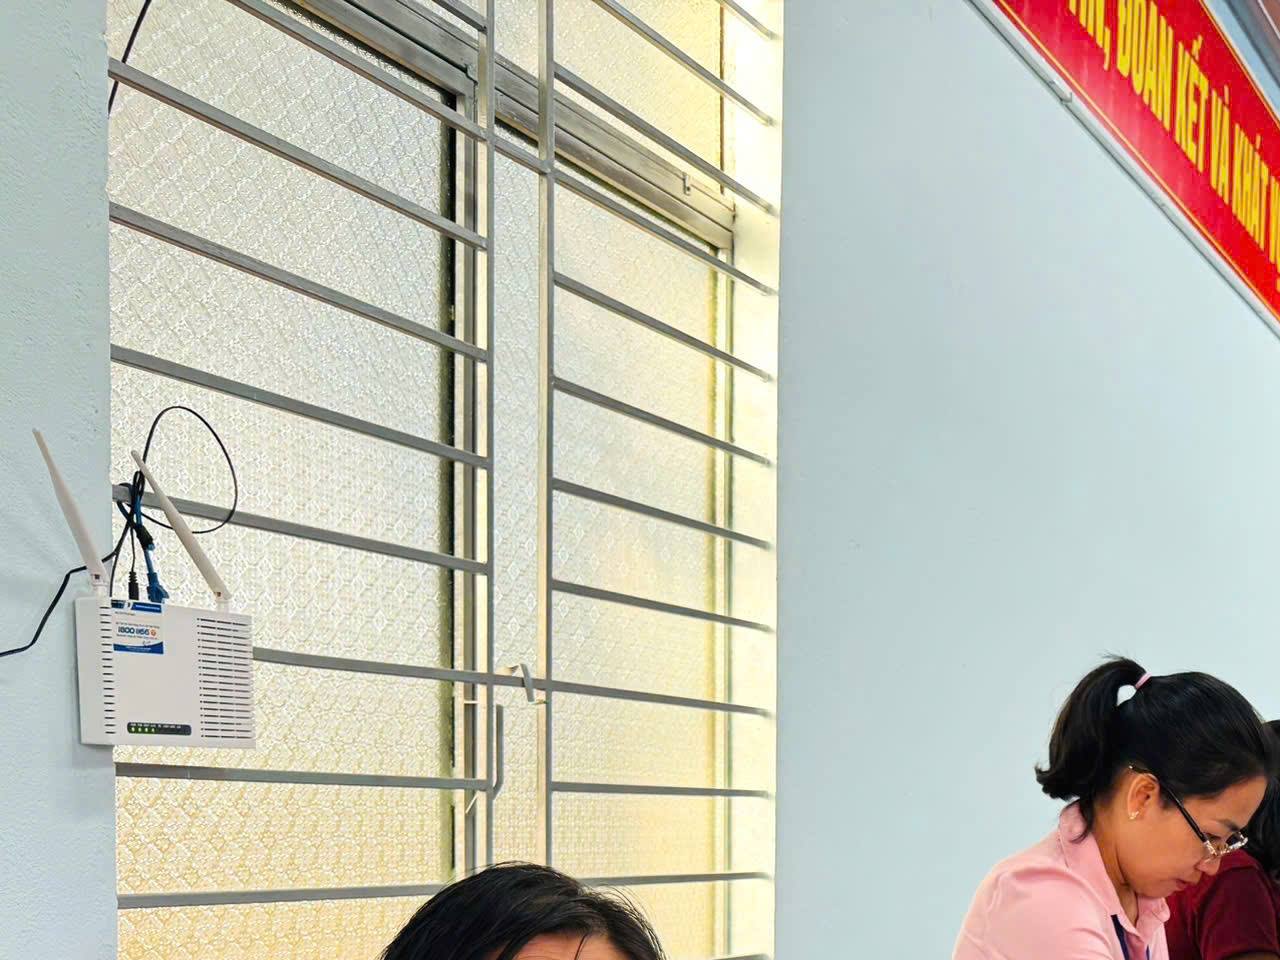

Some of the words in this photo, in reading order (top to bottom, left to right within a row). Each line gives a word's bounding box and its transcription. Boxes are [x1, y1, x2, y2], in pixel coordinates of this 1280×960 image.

[1175, 35, 1209, 173] KẾT
[1211, 84, 1230, 205] VÀ
[1232, 123, 1269, 251] KHÁT
